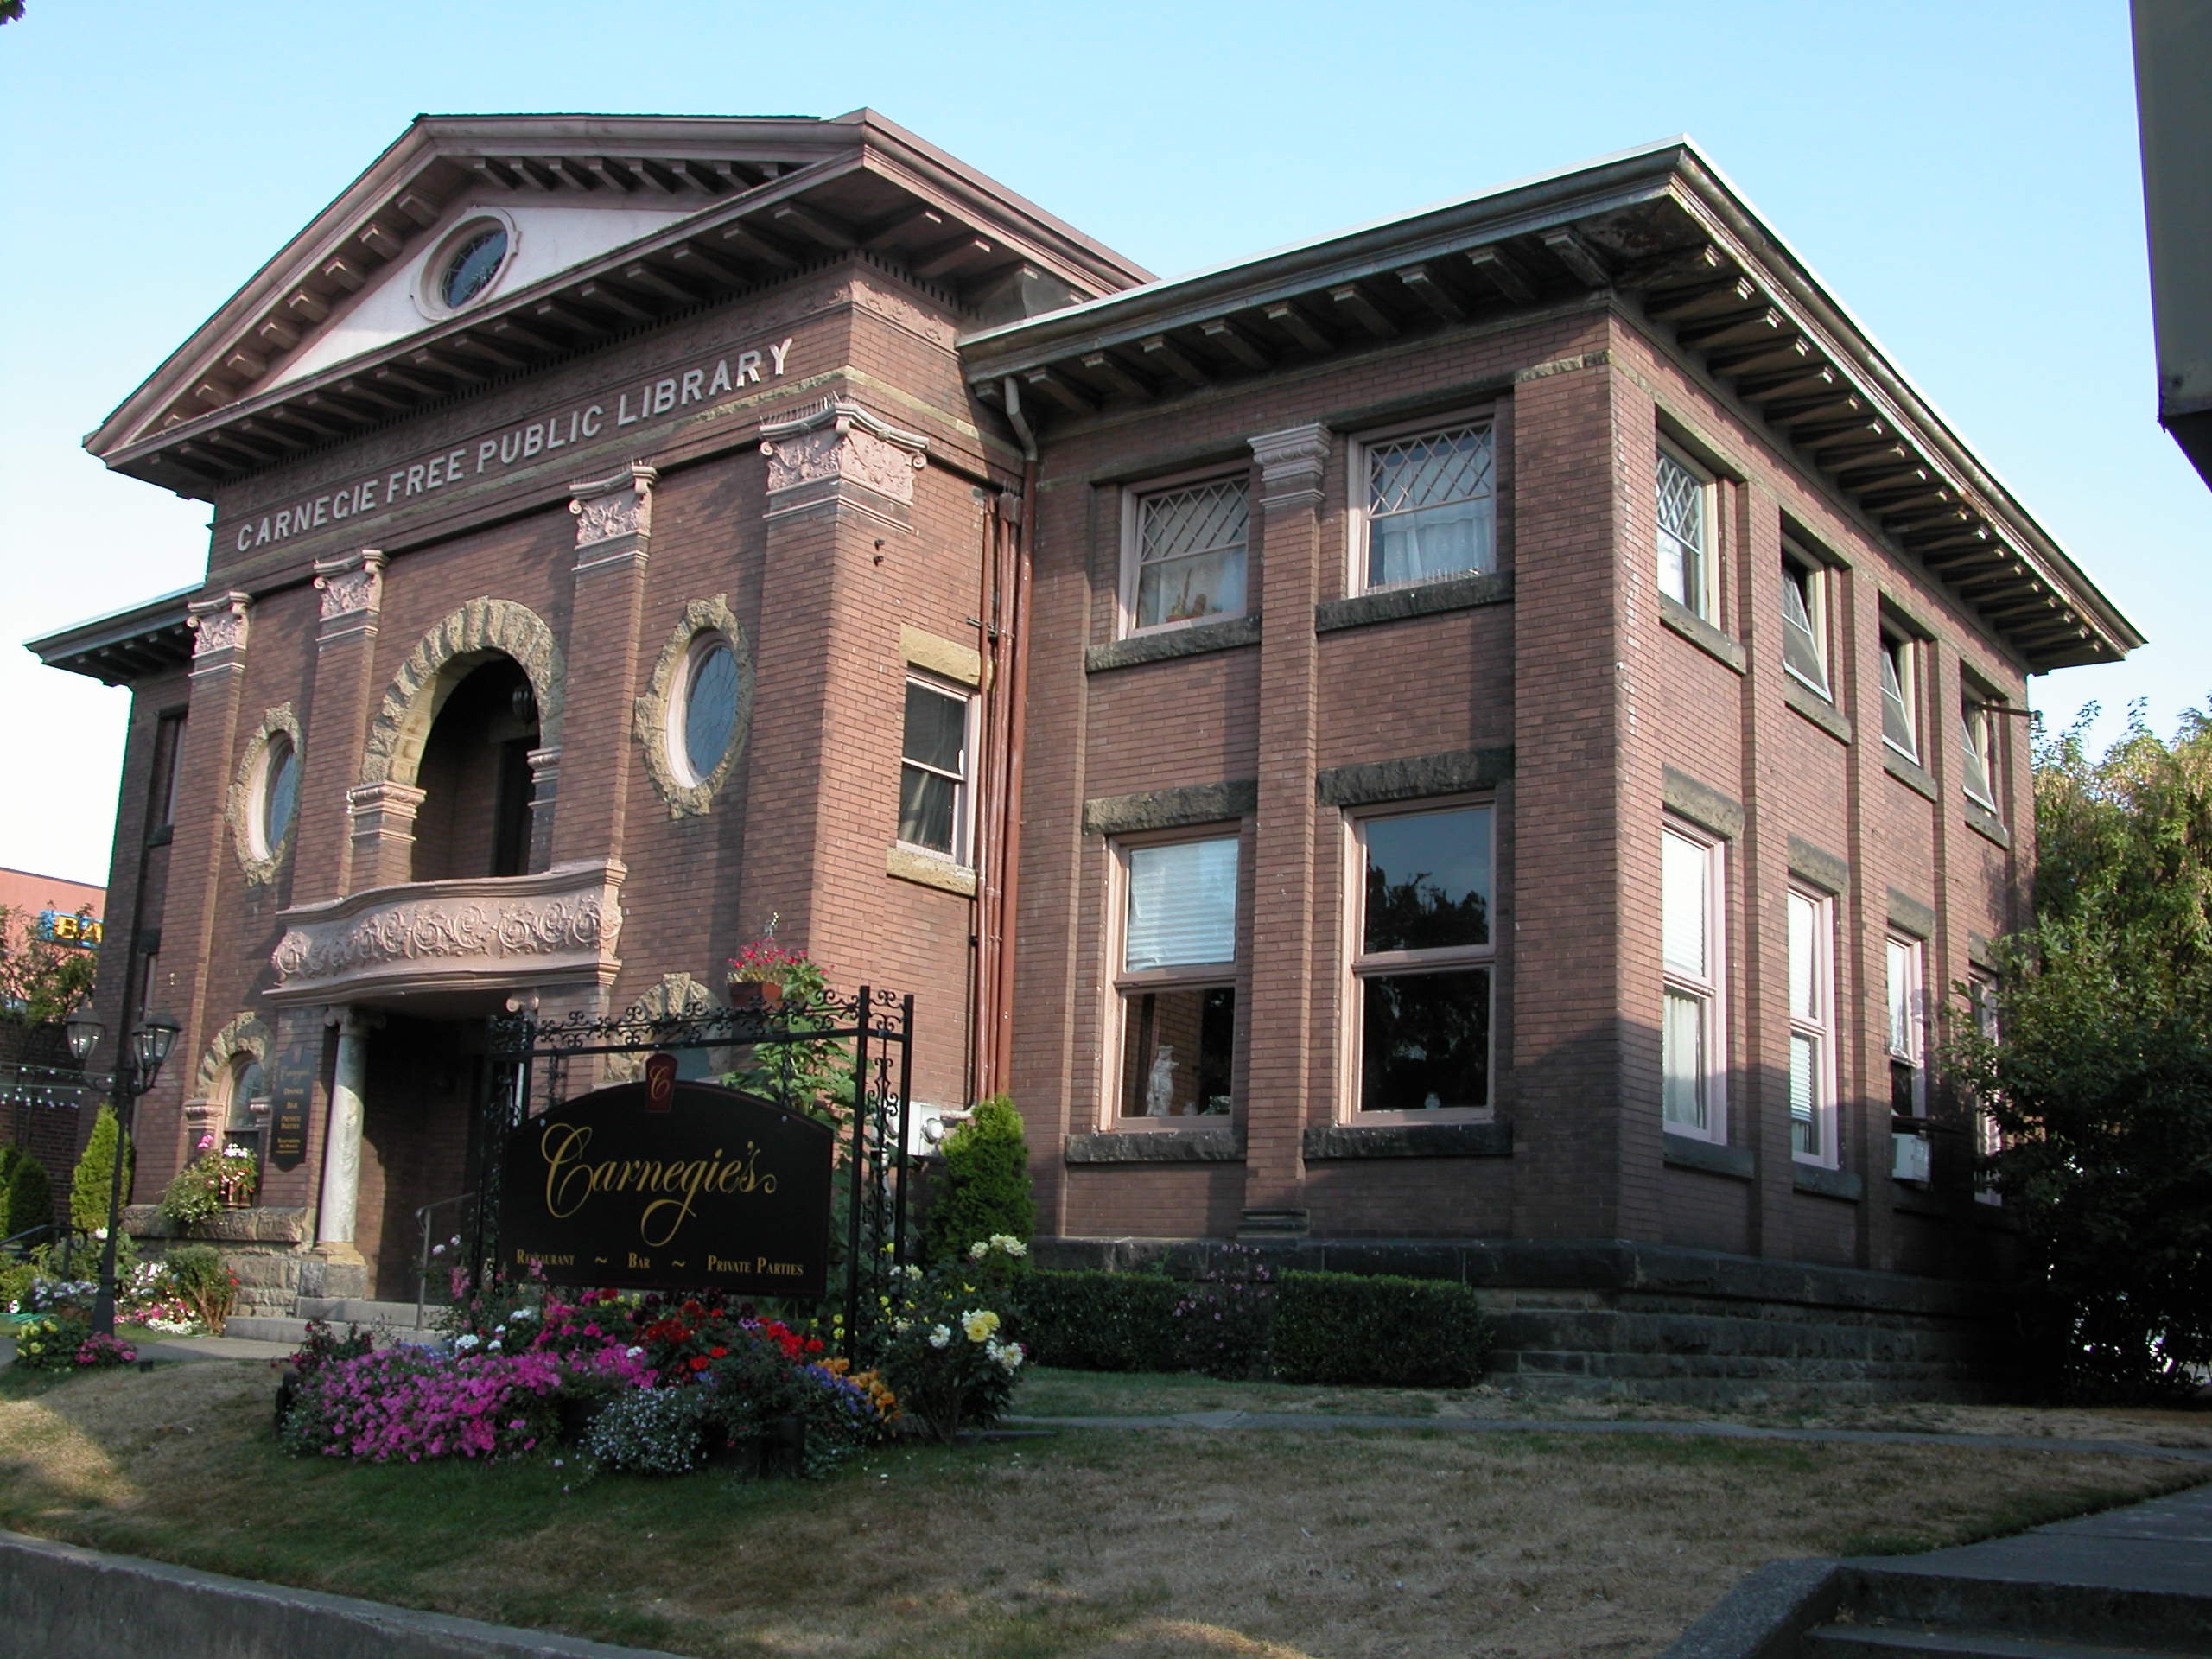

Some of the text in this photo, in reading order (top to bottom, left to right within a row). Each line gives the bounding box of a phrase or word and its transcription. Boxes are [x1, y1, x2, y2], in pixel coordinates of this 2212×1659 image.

[237, 338, 792, 552] CARNEGIE FREE PUBLIC LIBRARY
[541, 1123, 777, 1247] Carnegie's
